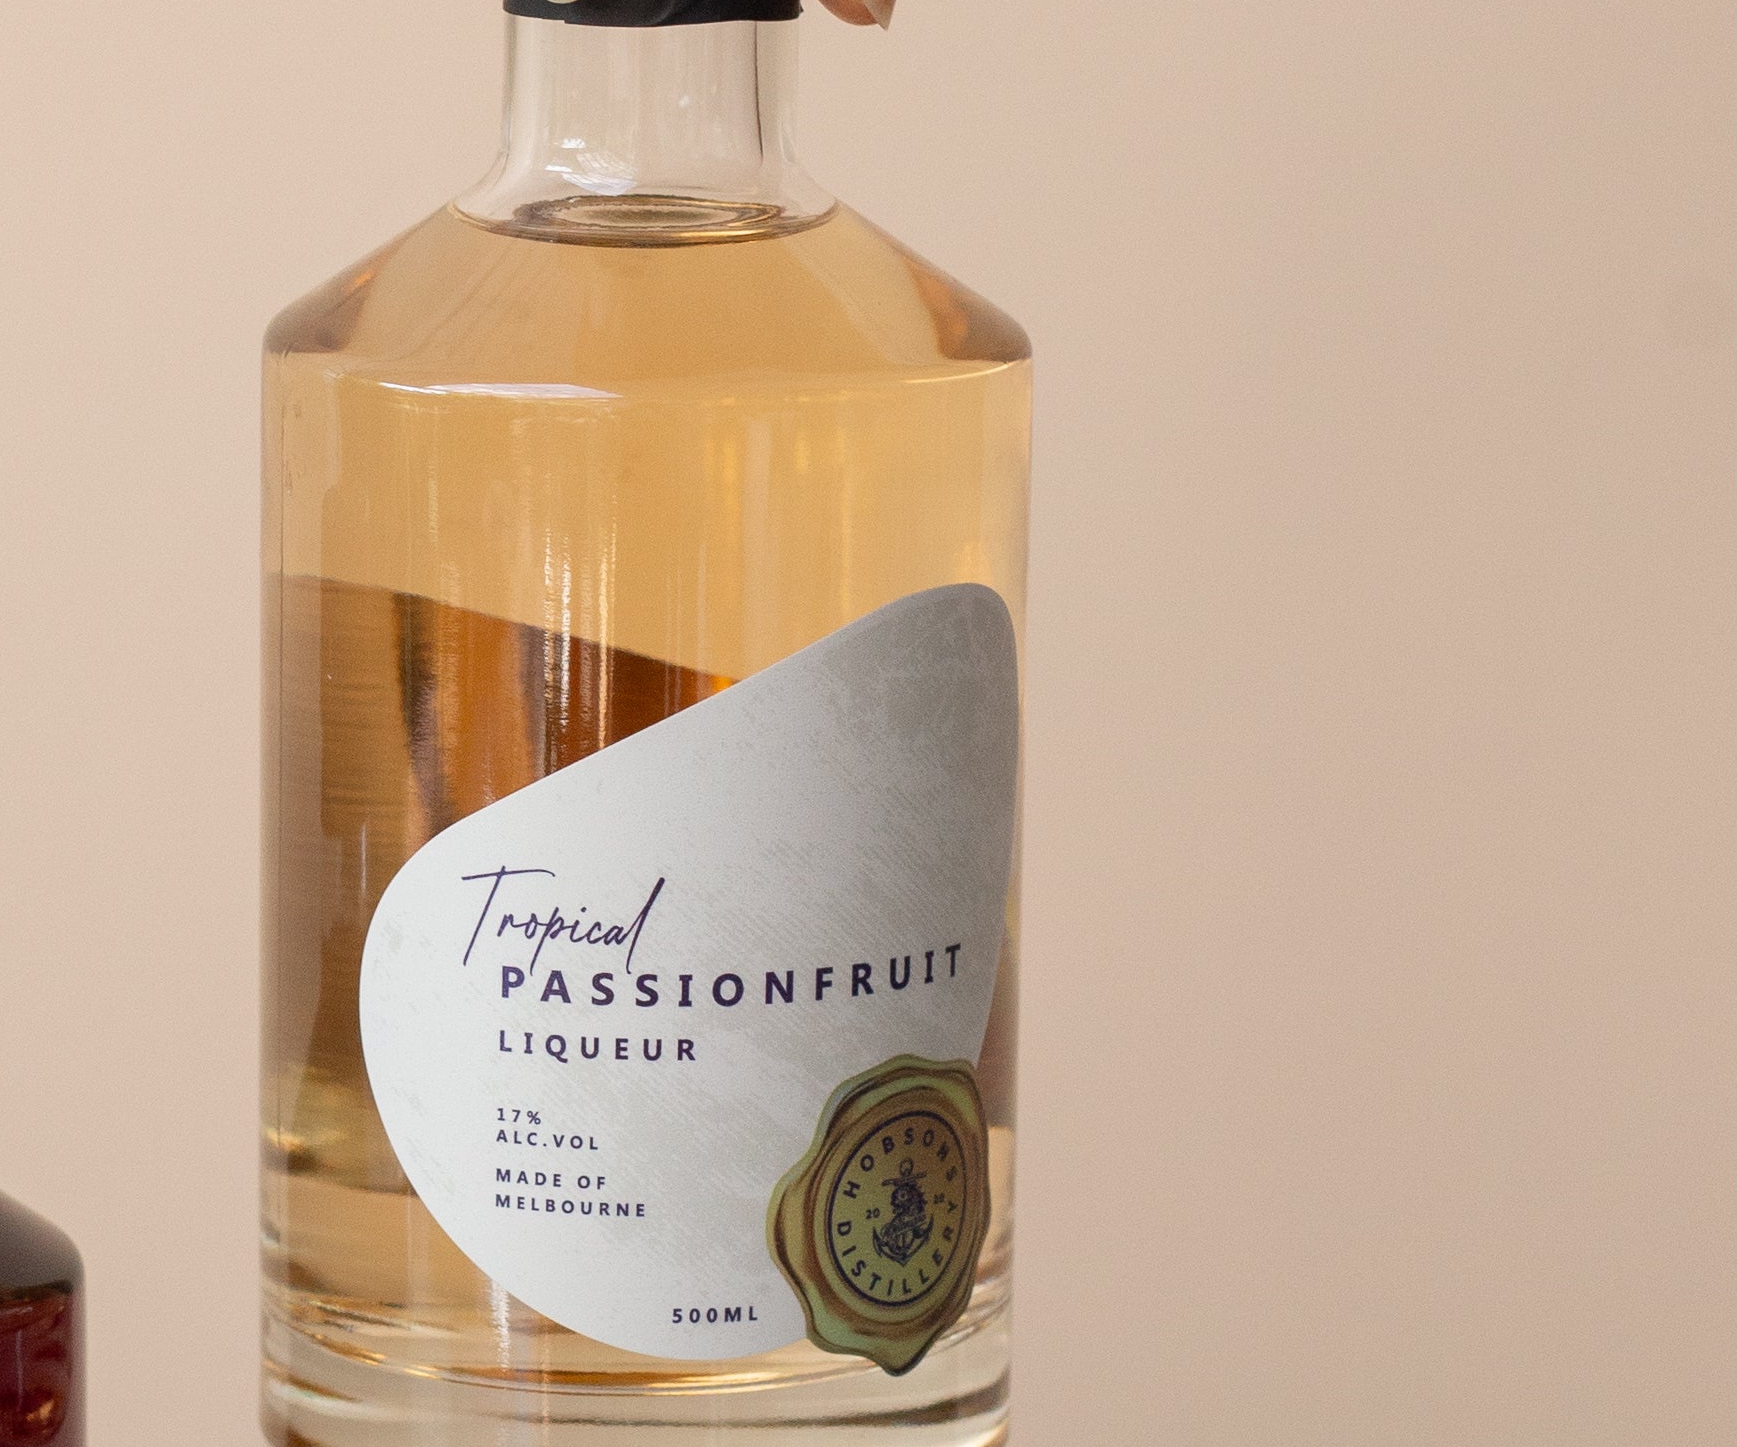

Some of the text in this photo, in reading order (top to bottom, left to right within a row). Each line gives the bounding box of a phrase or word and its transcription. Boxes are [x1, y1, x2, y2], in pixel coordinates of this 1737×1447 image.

[461, 865, 667, 975] Tropical
[500, 943, 962, 1009] PASSIONFRUIT
[499, 1029, 697, 1064] LIQUEUR
[497, 1107, 542, 1126] 17%
[496, 1129, 599, 1151] ALC.VOL
[842, 1127, 958, 1200] HOBSONS
[495, 1167, 606, 1191] MADE OF
[495, 1193, 646, 1218] MELBOURNE
[836, 1200, 958, 1296] DISTILLERY
[672, 1305, 759, 1325] 500ML
